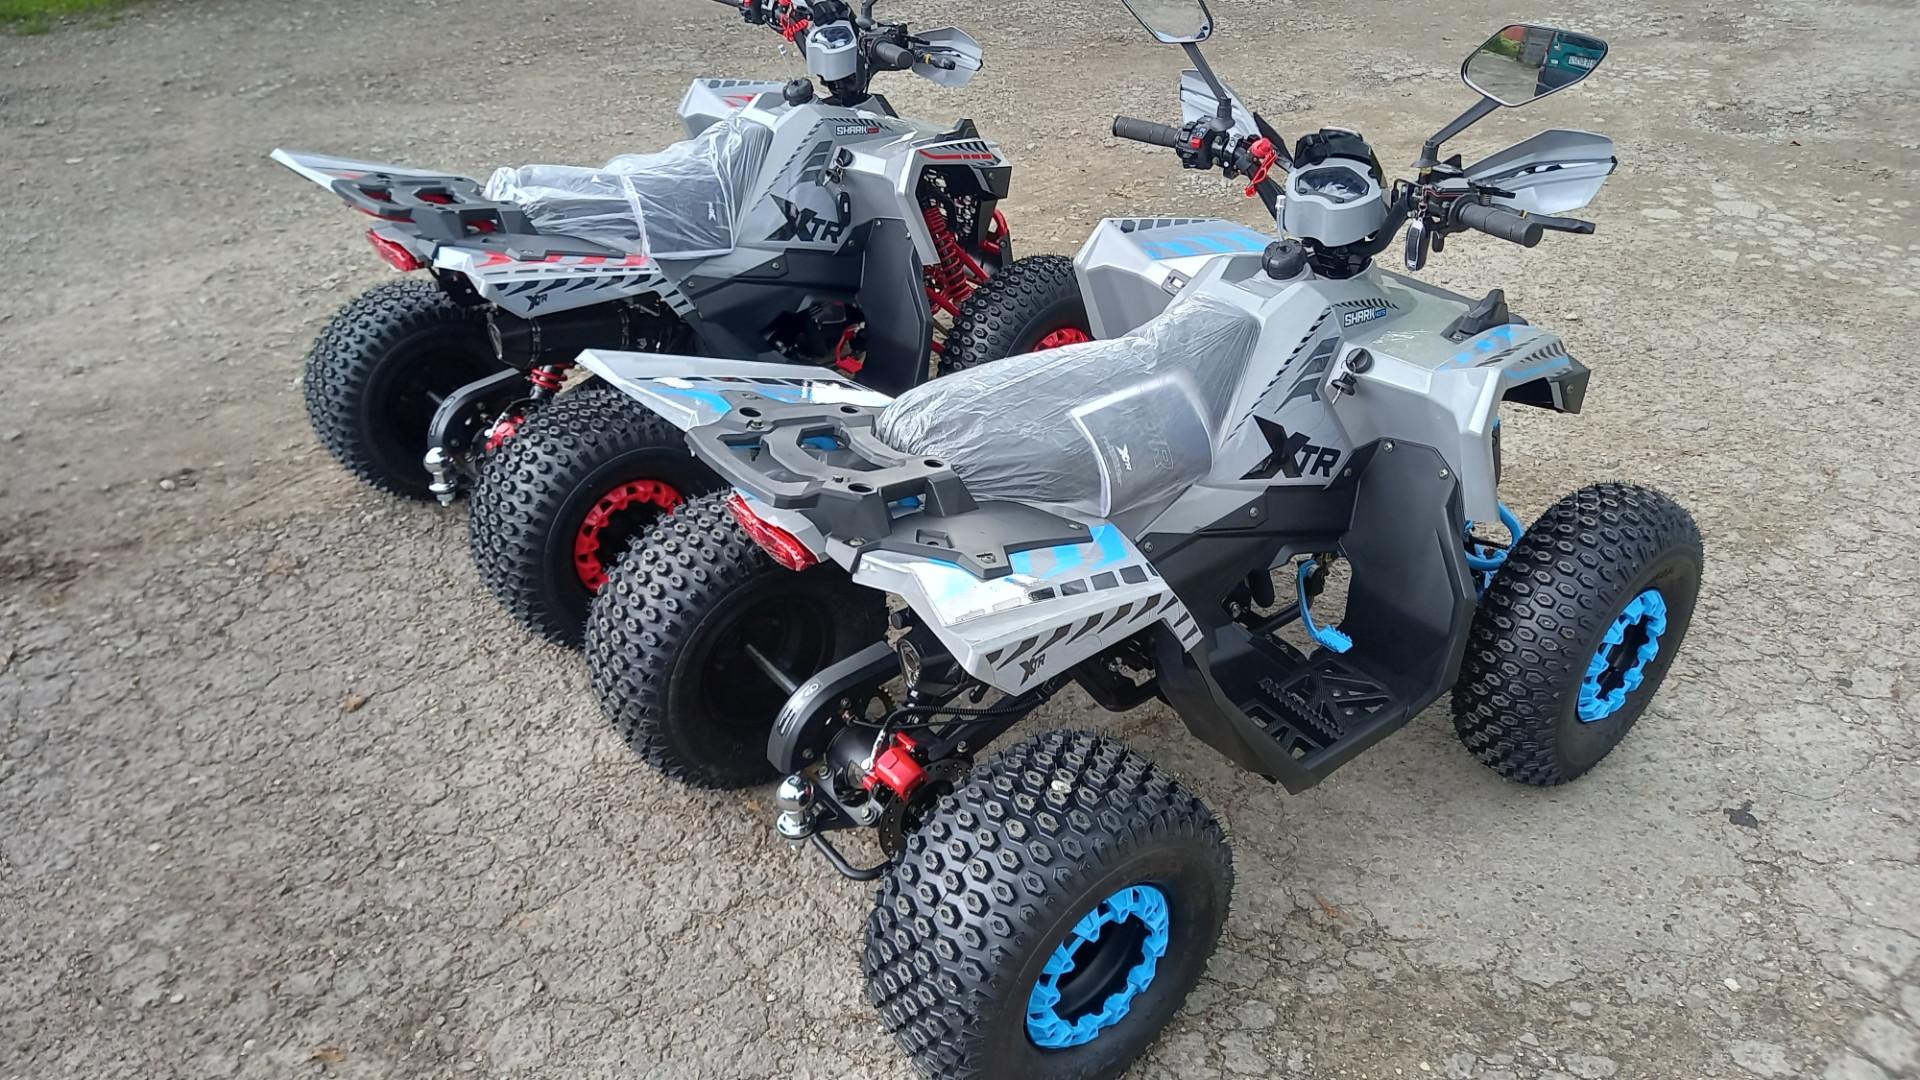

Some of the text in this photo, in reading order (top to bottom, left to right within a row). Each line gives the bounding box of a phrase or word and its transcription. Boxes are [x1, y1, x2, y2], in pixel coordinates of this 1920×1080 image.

[836, 125, 868, 136] SHARK
[764, 194, 847, 244] XTR
[525, 293, 548, 312] XTR
[1344, 308, 1375, 327] SHARK
[1239, 415, 1341, 480] XTR
[1019, 653, 1046, 687] XTR
